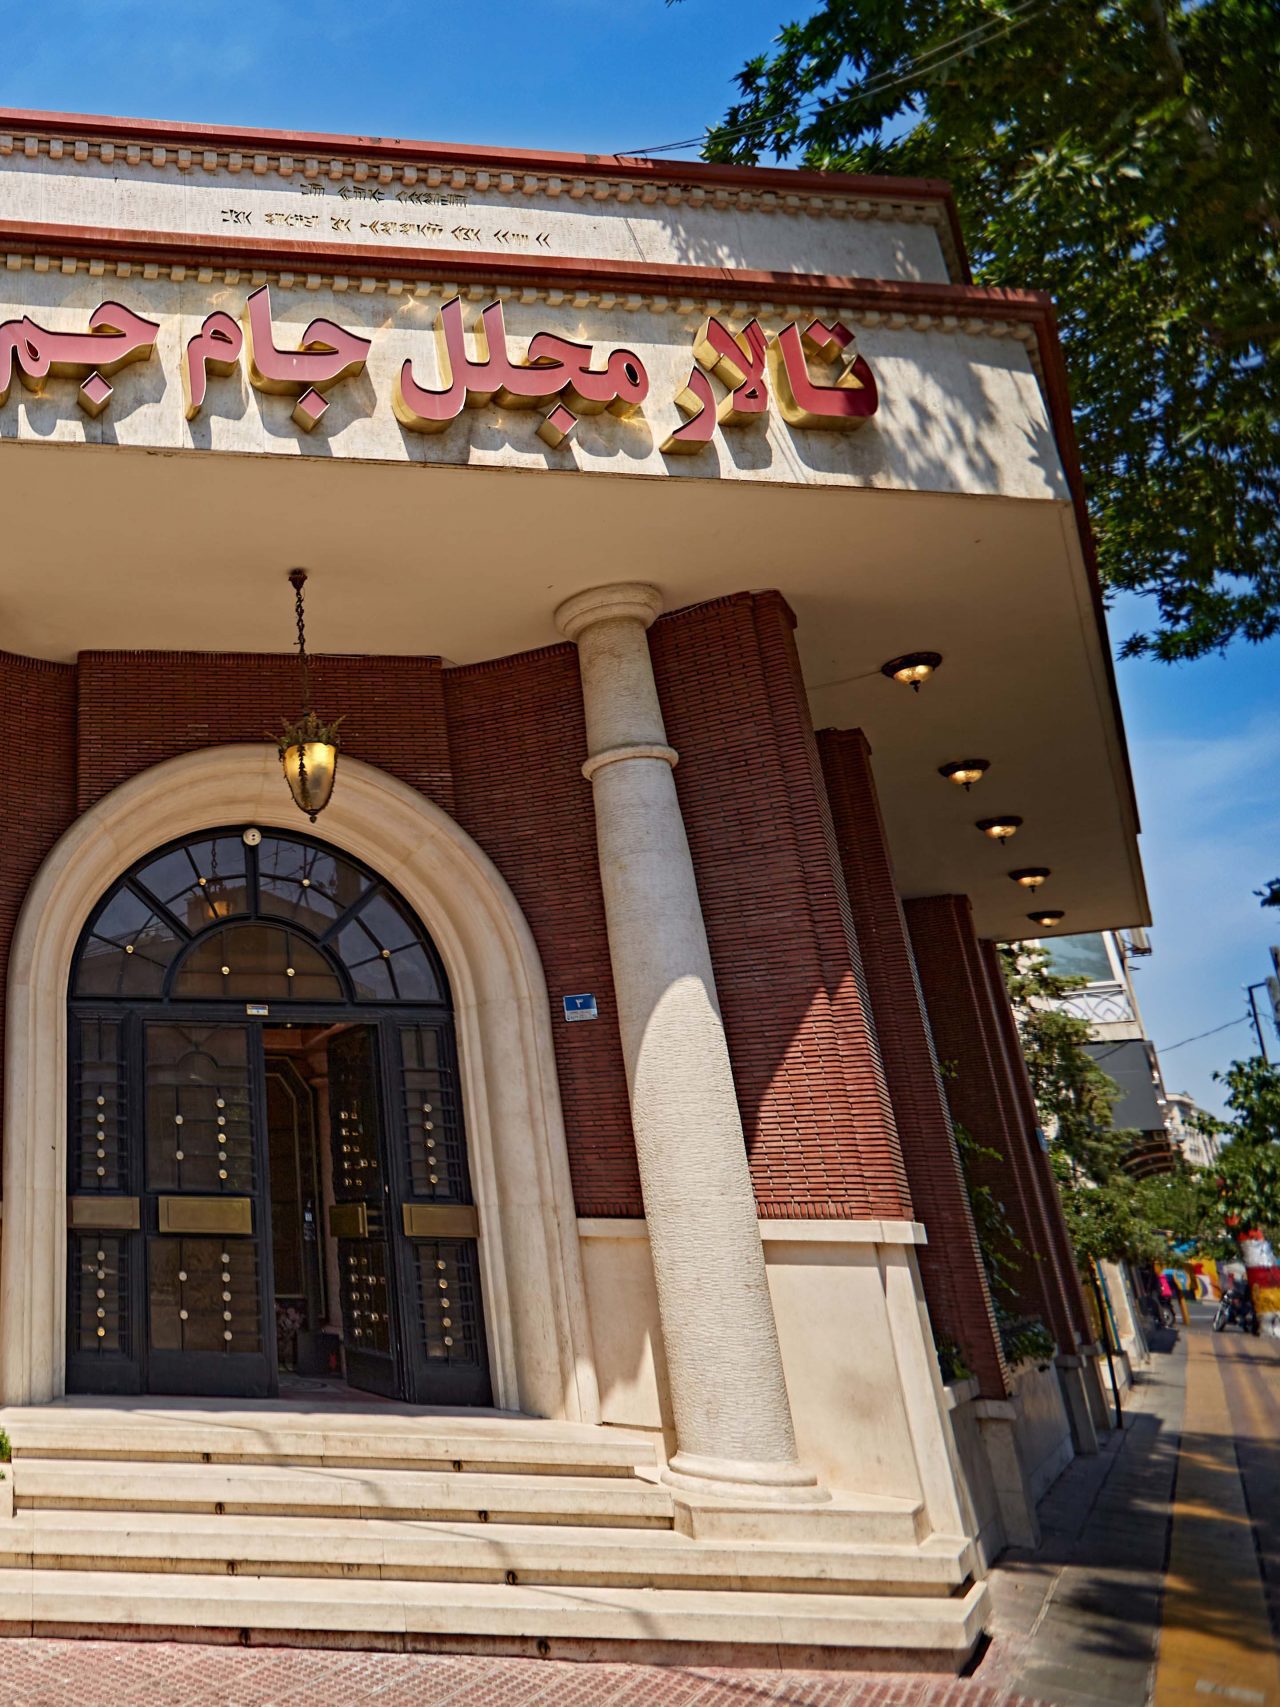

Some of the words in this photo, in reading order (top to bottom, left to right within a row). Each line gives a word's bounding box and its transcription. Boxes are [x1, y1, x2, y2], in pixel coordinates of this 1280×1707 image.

[186, 284, 372, 433] جام
[392, 295, 650, 448] مجلل
[661, 315, 879, 455] تالار
